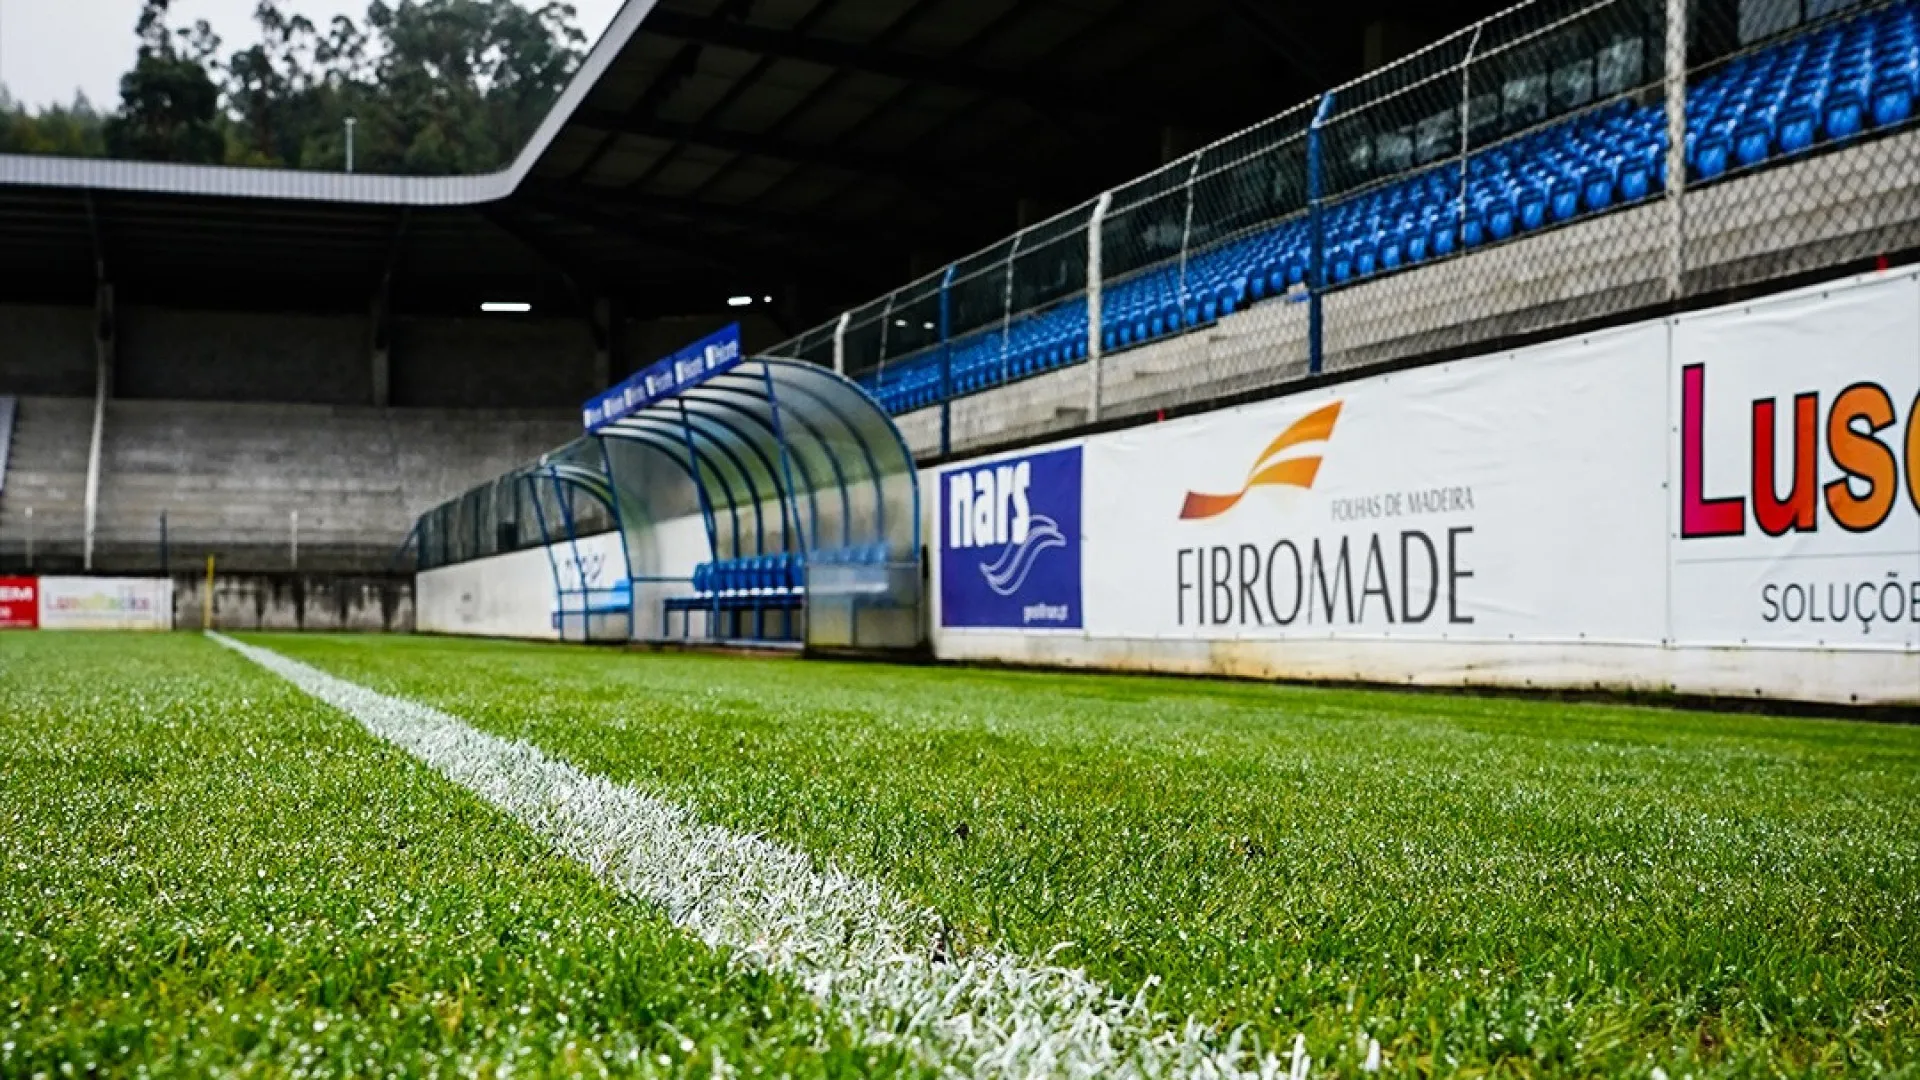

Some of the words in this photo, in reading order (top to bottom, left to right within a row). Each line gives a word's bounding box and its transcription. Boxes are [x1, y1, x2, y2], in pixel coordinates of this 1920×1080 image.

[1681, 362, 1920, 540] Lus
[950, 460, 1030, 549] nars
[1331, 493, 1381, 521] FOLHAS
[1384, 491, 1402, 517] DE
[1407, 485, 1474, 514] MADEIRA
[1178, 526, 1475, 626] FIBROMADE
